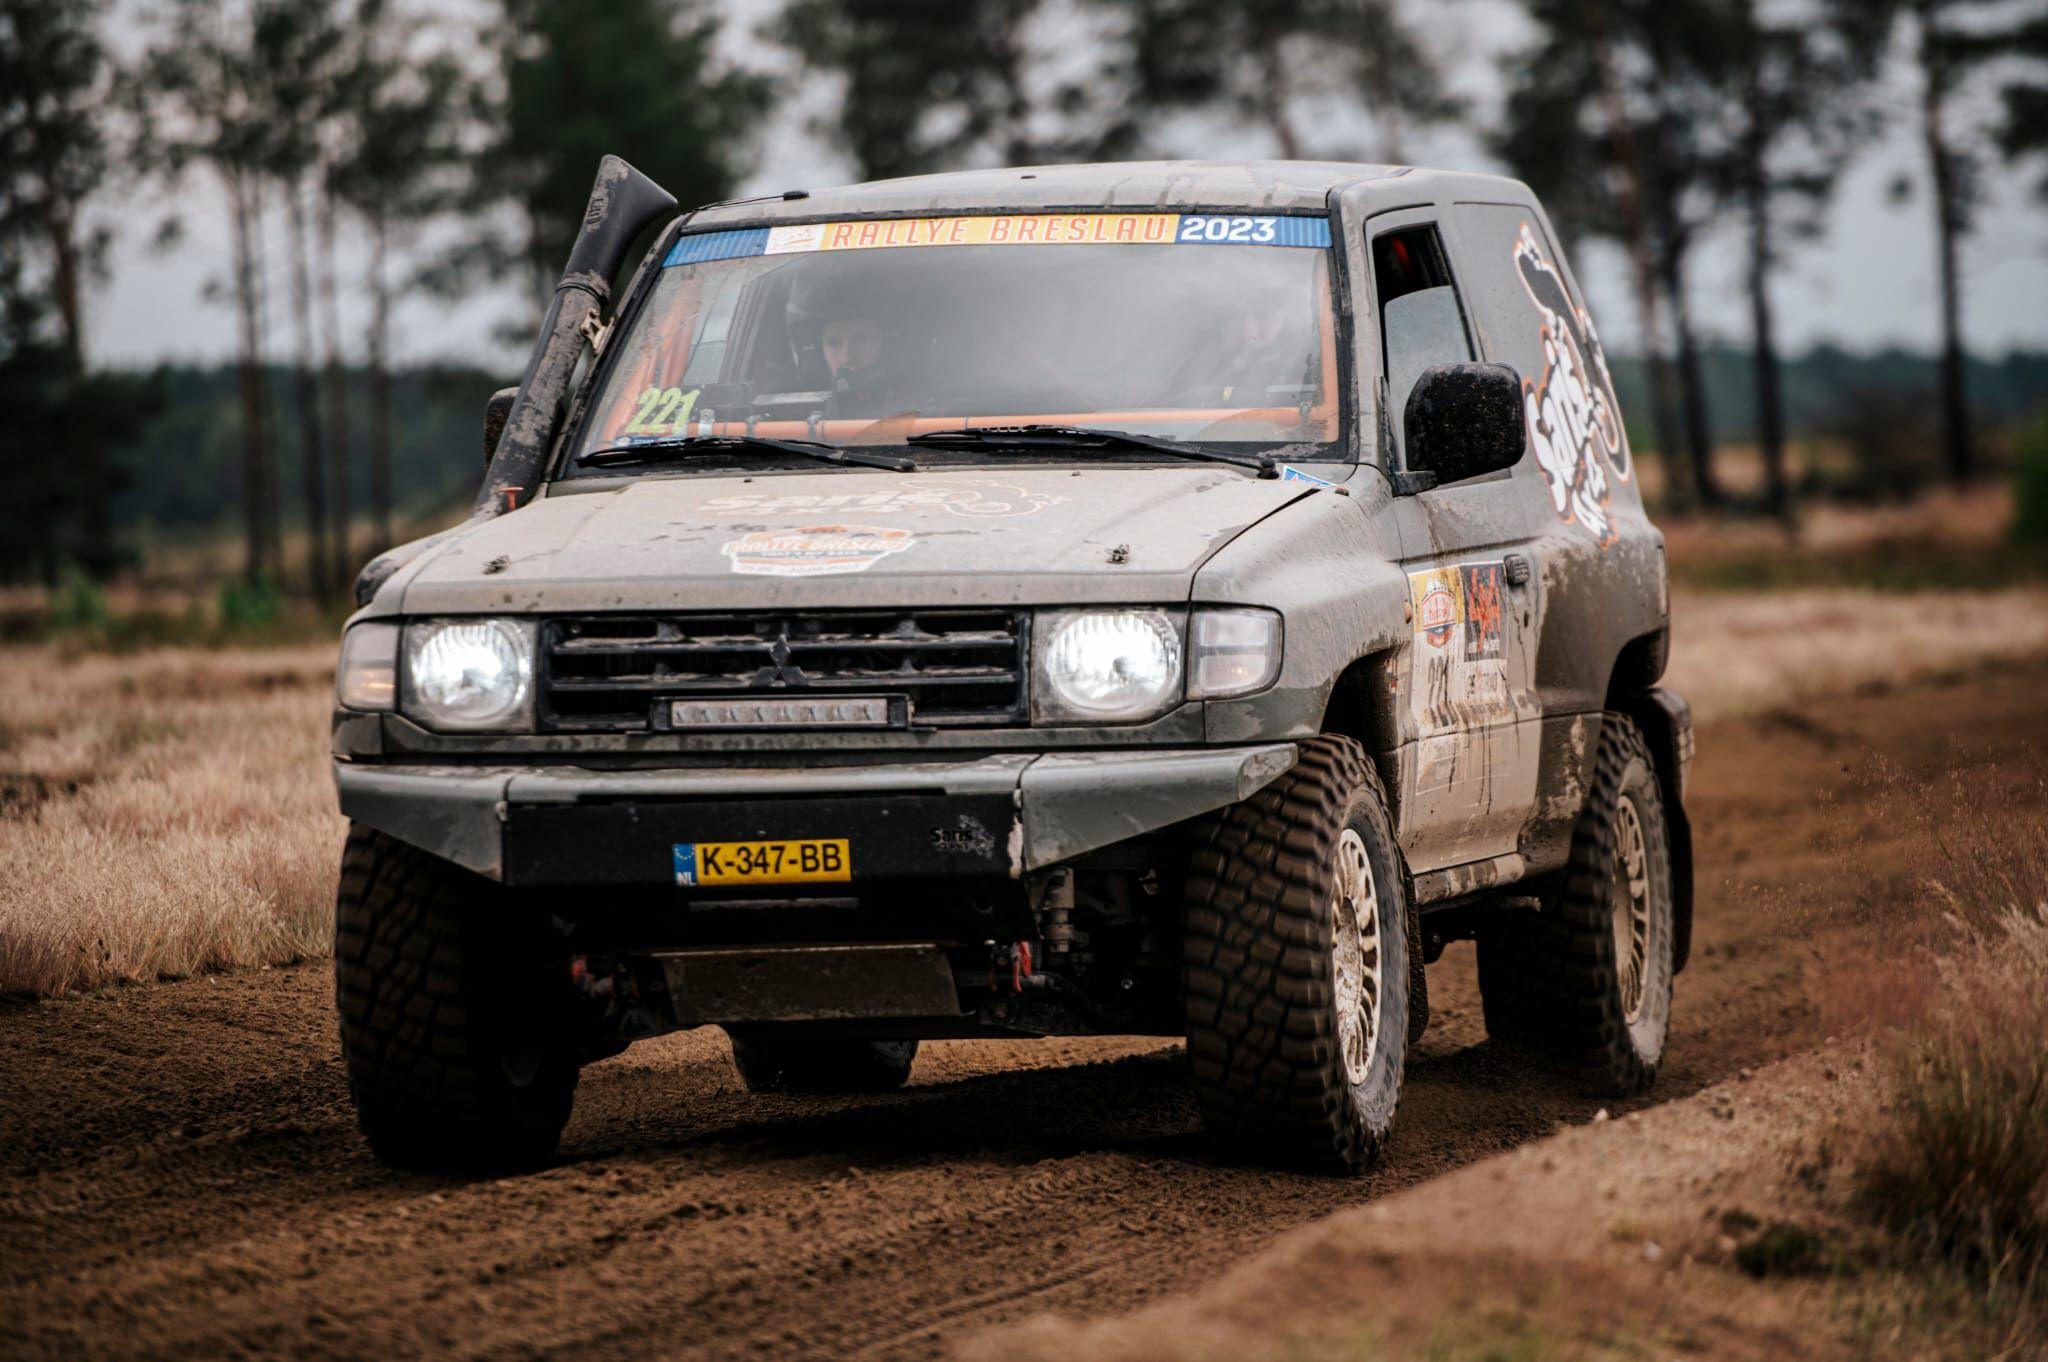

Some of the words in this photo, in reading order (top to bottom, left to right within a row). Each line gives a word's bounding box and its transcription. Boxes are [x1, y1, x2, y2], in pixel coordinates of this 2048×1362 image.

[831, 218, 969, 248] RALLYE
[989, 215, 1168, 242] BRESLAU
[1181, 217, 1277, 242] 2023
[625, 387, 701, 435] 221
[702, 843, 842, 876] K-347-BB
[676, 871, 697, 887] NL
